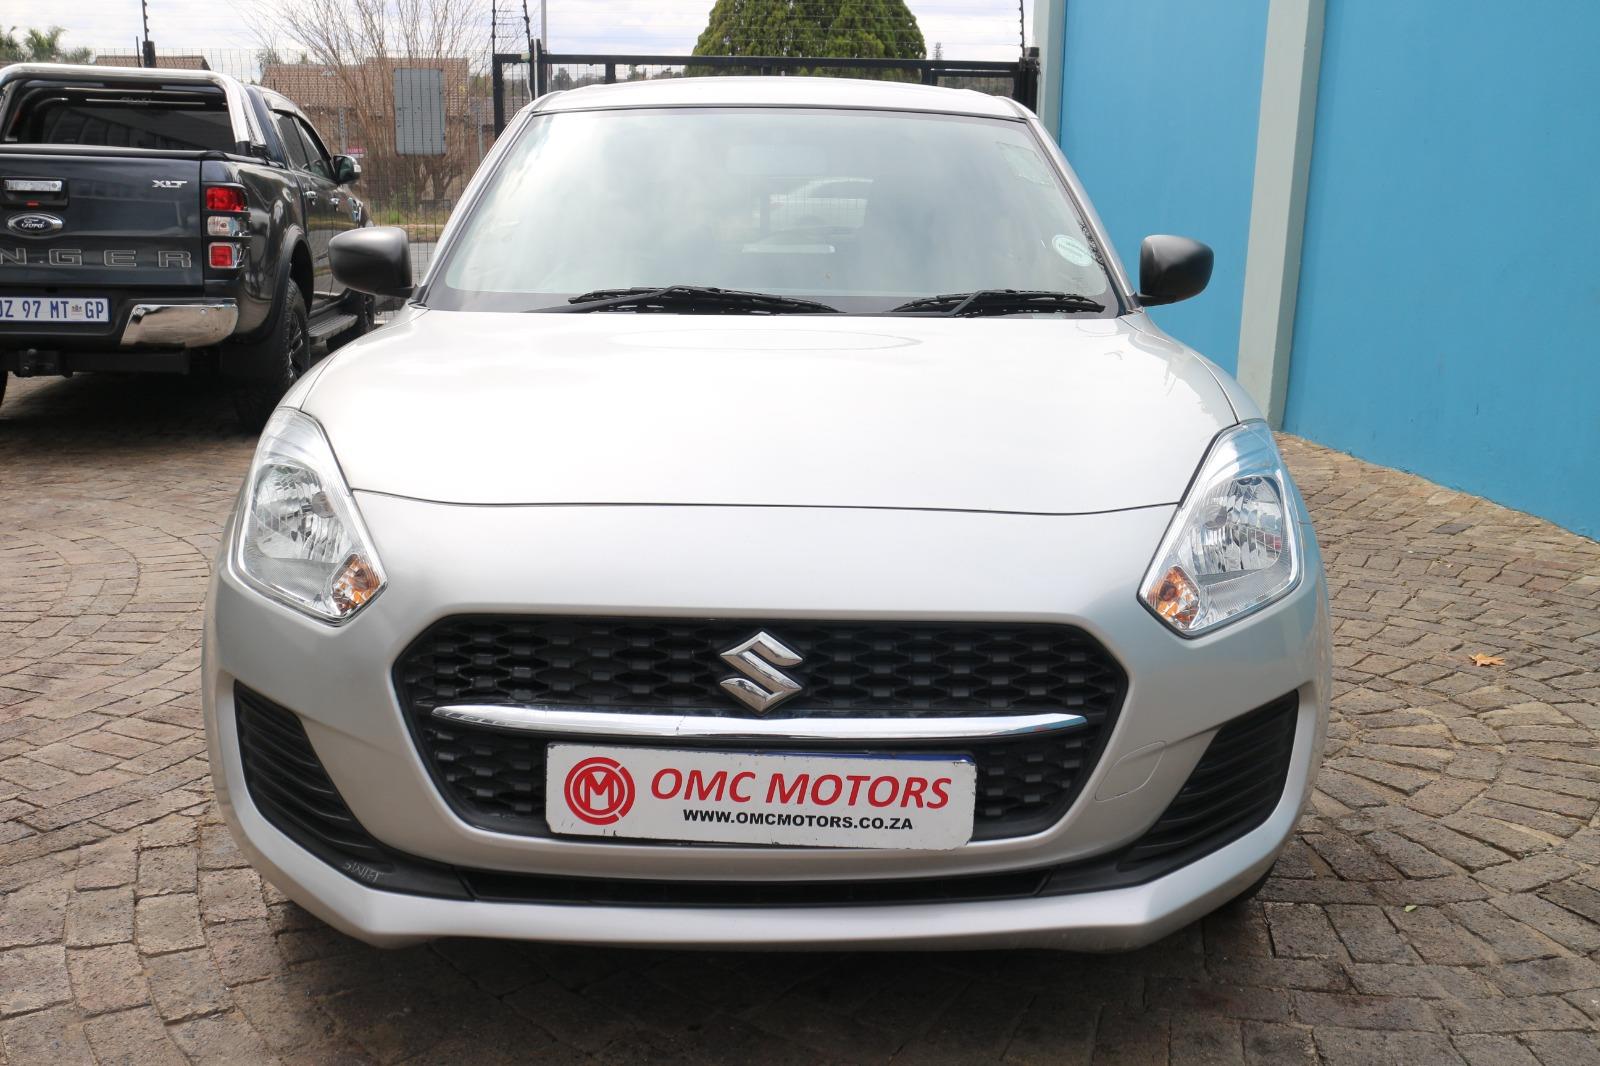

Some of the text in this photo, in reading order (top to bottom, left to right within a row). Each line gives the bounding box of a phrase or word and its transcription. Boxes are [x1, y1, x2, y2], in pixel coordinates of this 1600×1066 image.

[152, 179, 188, 189] XLT
[21, 217, 45, 229] Ford
[0, 300, 104, 319] Z 97 MT GP
[650, 767, 952, 809] OMC MOTORS
[683, 809, 913, 830] WWW.OMCMOTORS.CO.ZA
